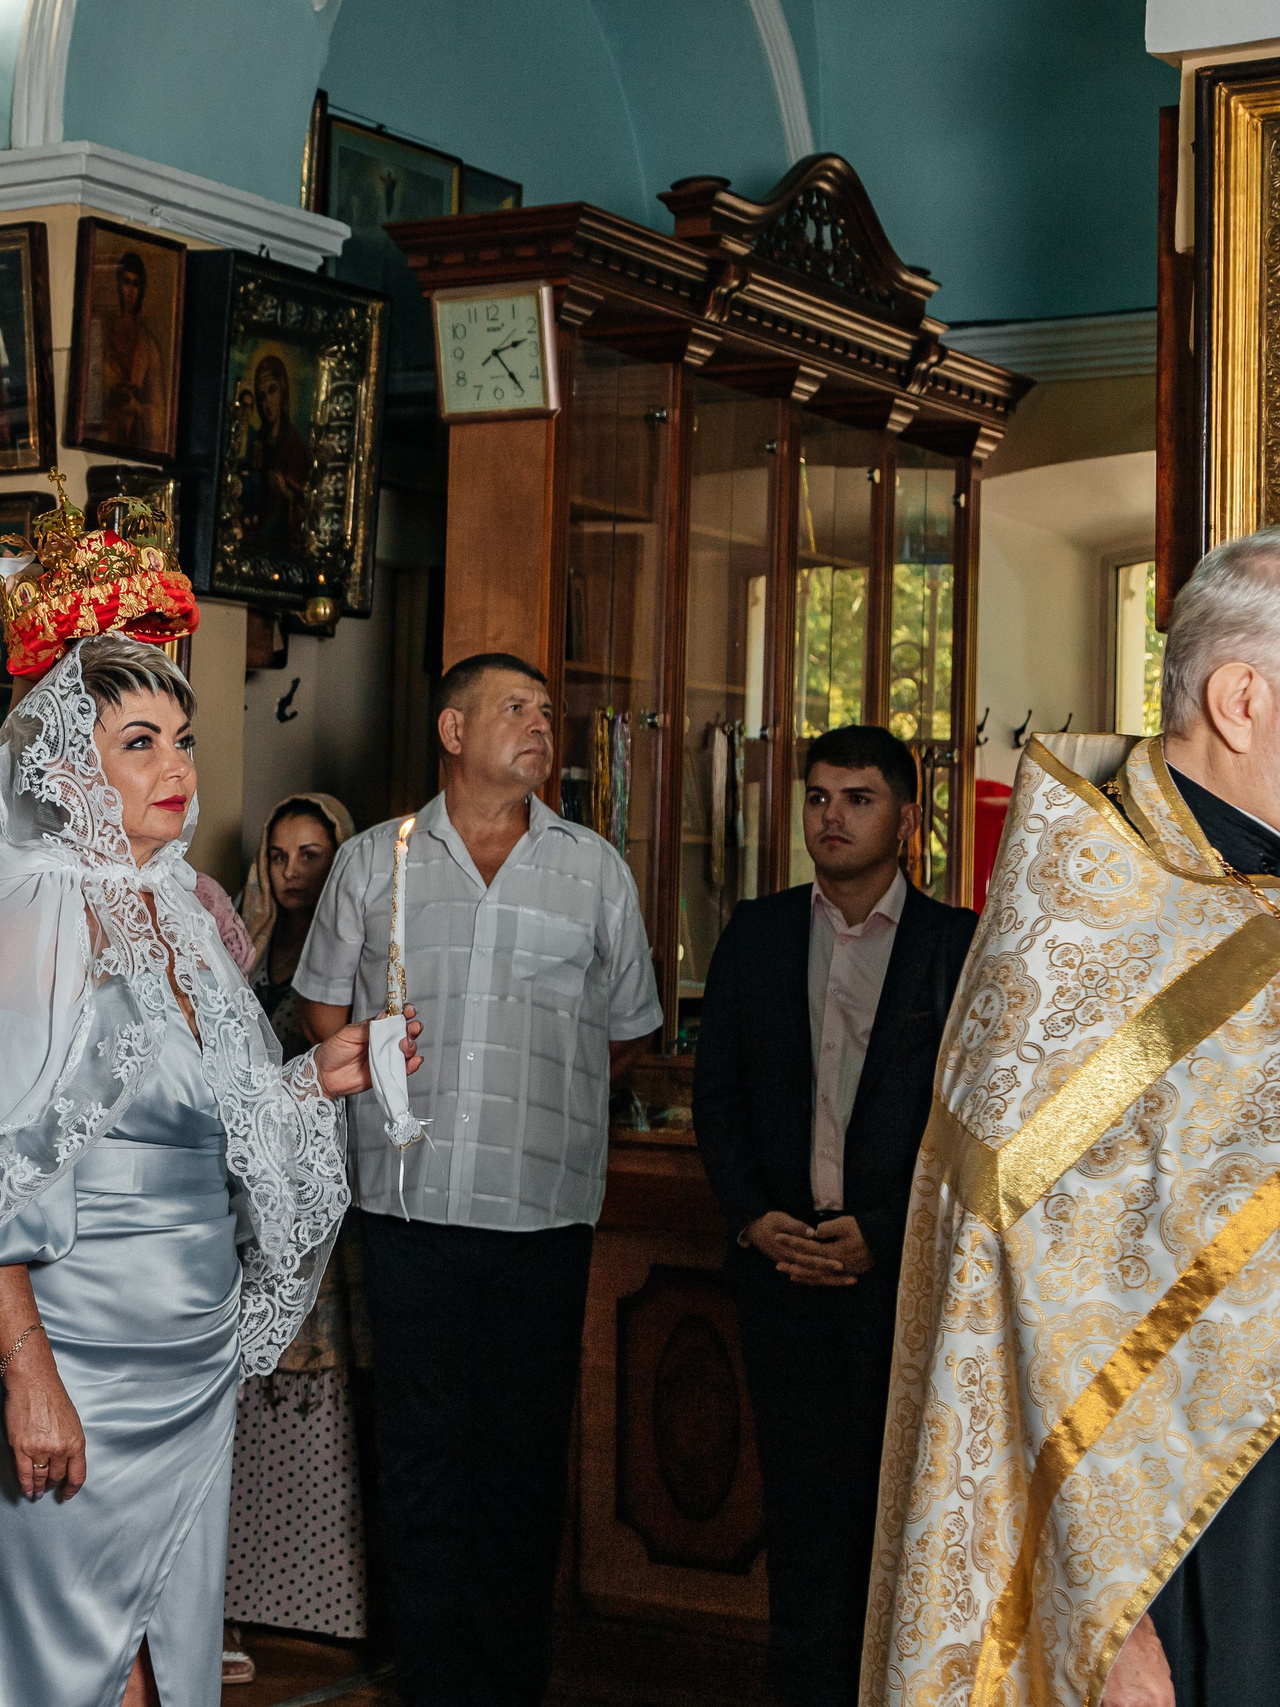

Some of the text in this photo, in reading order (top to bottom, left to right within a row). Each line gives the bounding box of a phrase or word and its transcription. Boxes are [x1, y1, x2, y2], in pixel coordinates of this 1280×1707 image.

[468, 307, 478, 323] 11
[486, 304, 499, 321] 12
[511, 303, 517, 320] 1
[451, 323, 467, 340] 10
[525, 316, 537, 334] 2
[453, 346, 465, 361] 9
[528, 340, 540, 358] 3
[456, 370, 468, 387] 8
[528, 366, 540, 381] 4
[473, 384, 484, 401] 7
